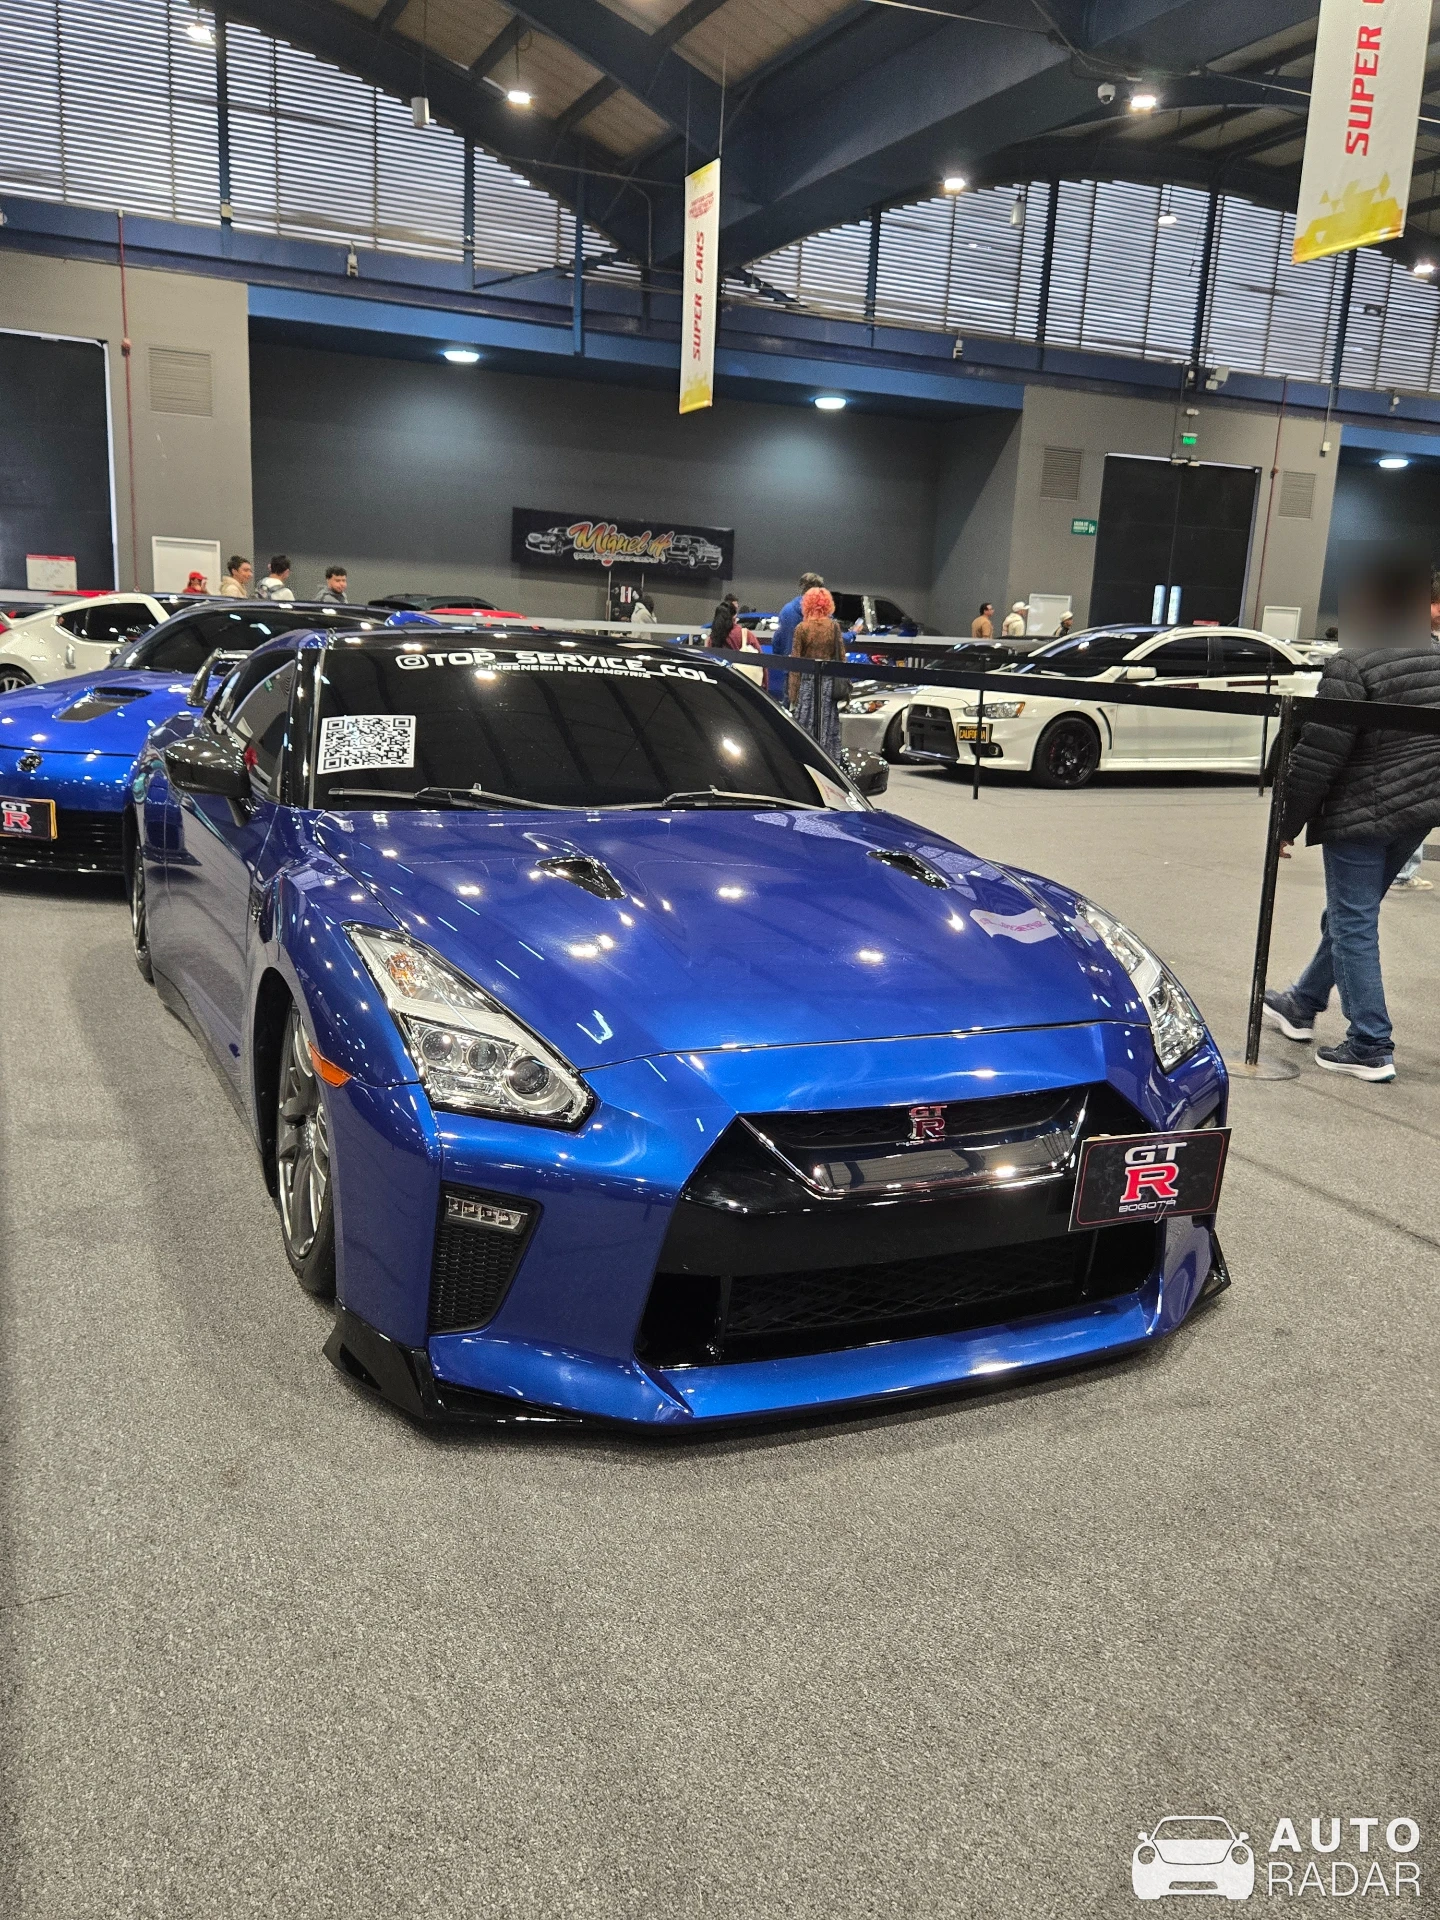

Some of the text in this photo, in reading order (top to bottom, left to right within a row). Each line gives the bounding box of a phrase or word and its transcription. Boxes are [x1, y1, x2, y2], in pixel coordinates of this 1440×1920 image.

[1345, 25, 1382, 157] SUPER
[693, 231, 704, 361] SUPER CARS
[567, 522, 651, 555] Miguel
[567, 666, 651, 679] AUTOMOTRIZ
[1, 801, 31, 812] GT
[3, 810, 32, 830] R
[909, 1105, 947, 1117] GT
[908, 1117, 946, 1140] R
[1124, 1142, 1187, 1165] GT
[1120, 1162, 1180, 1203] R
